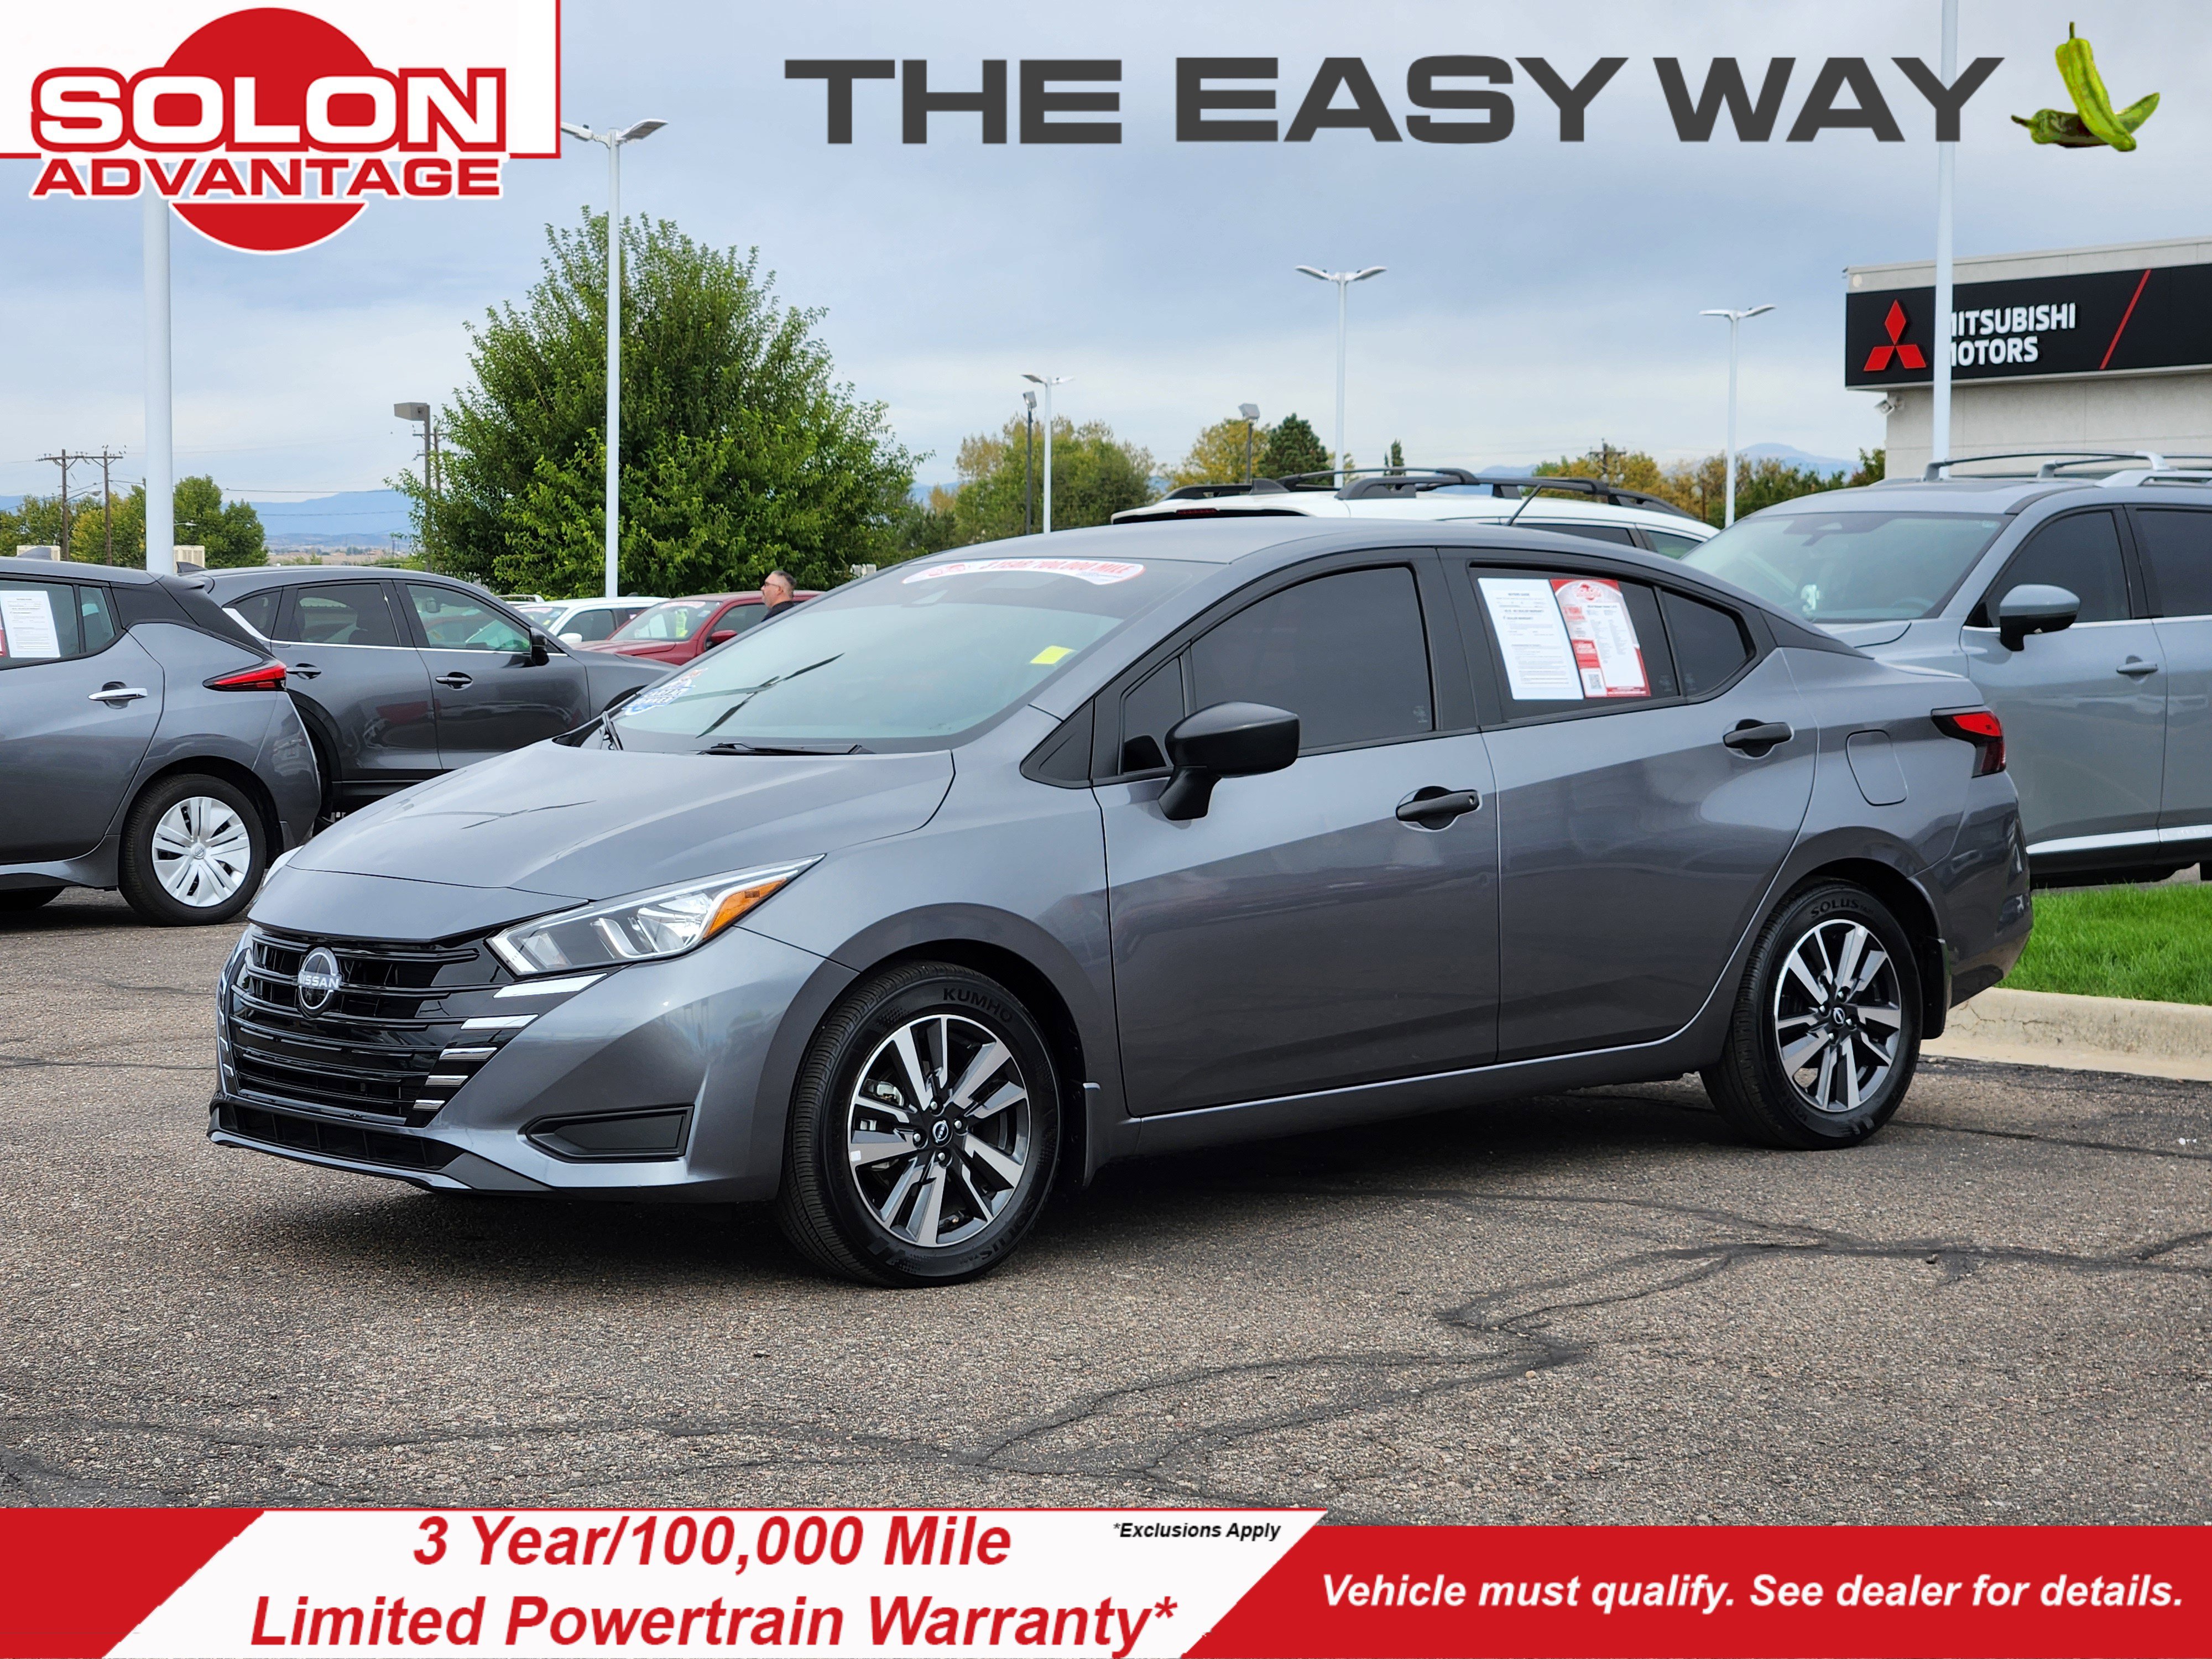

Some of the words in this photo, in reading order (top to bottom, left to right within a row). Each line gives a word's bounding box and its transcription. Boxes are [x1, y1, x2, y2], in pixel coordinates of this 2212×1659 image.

[1951, 302, 2076, 337] ITSUBISHI
[1951, 335, 2039, 367] OTORS
[1810, 898, 1859, 919] SOLUS
[298, 973, 340, 989] NISSAN
[942, 987, 1013, 1022] KUMHO
